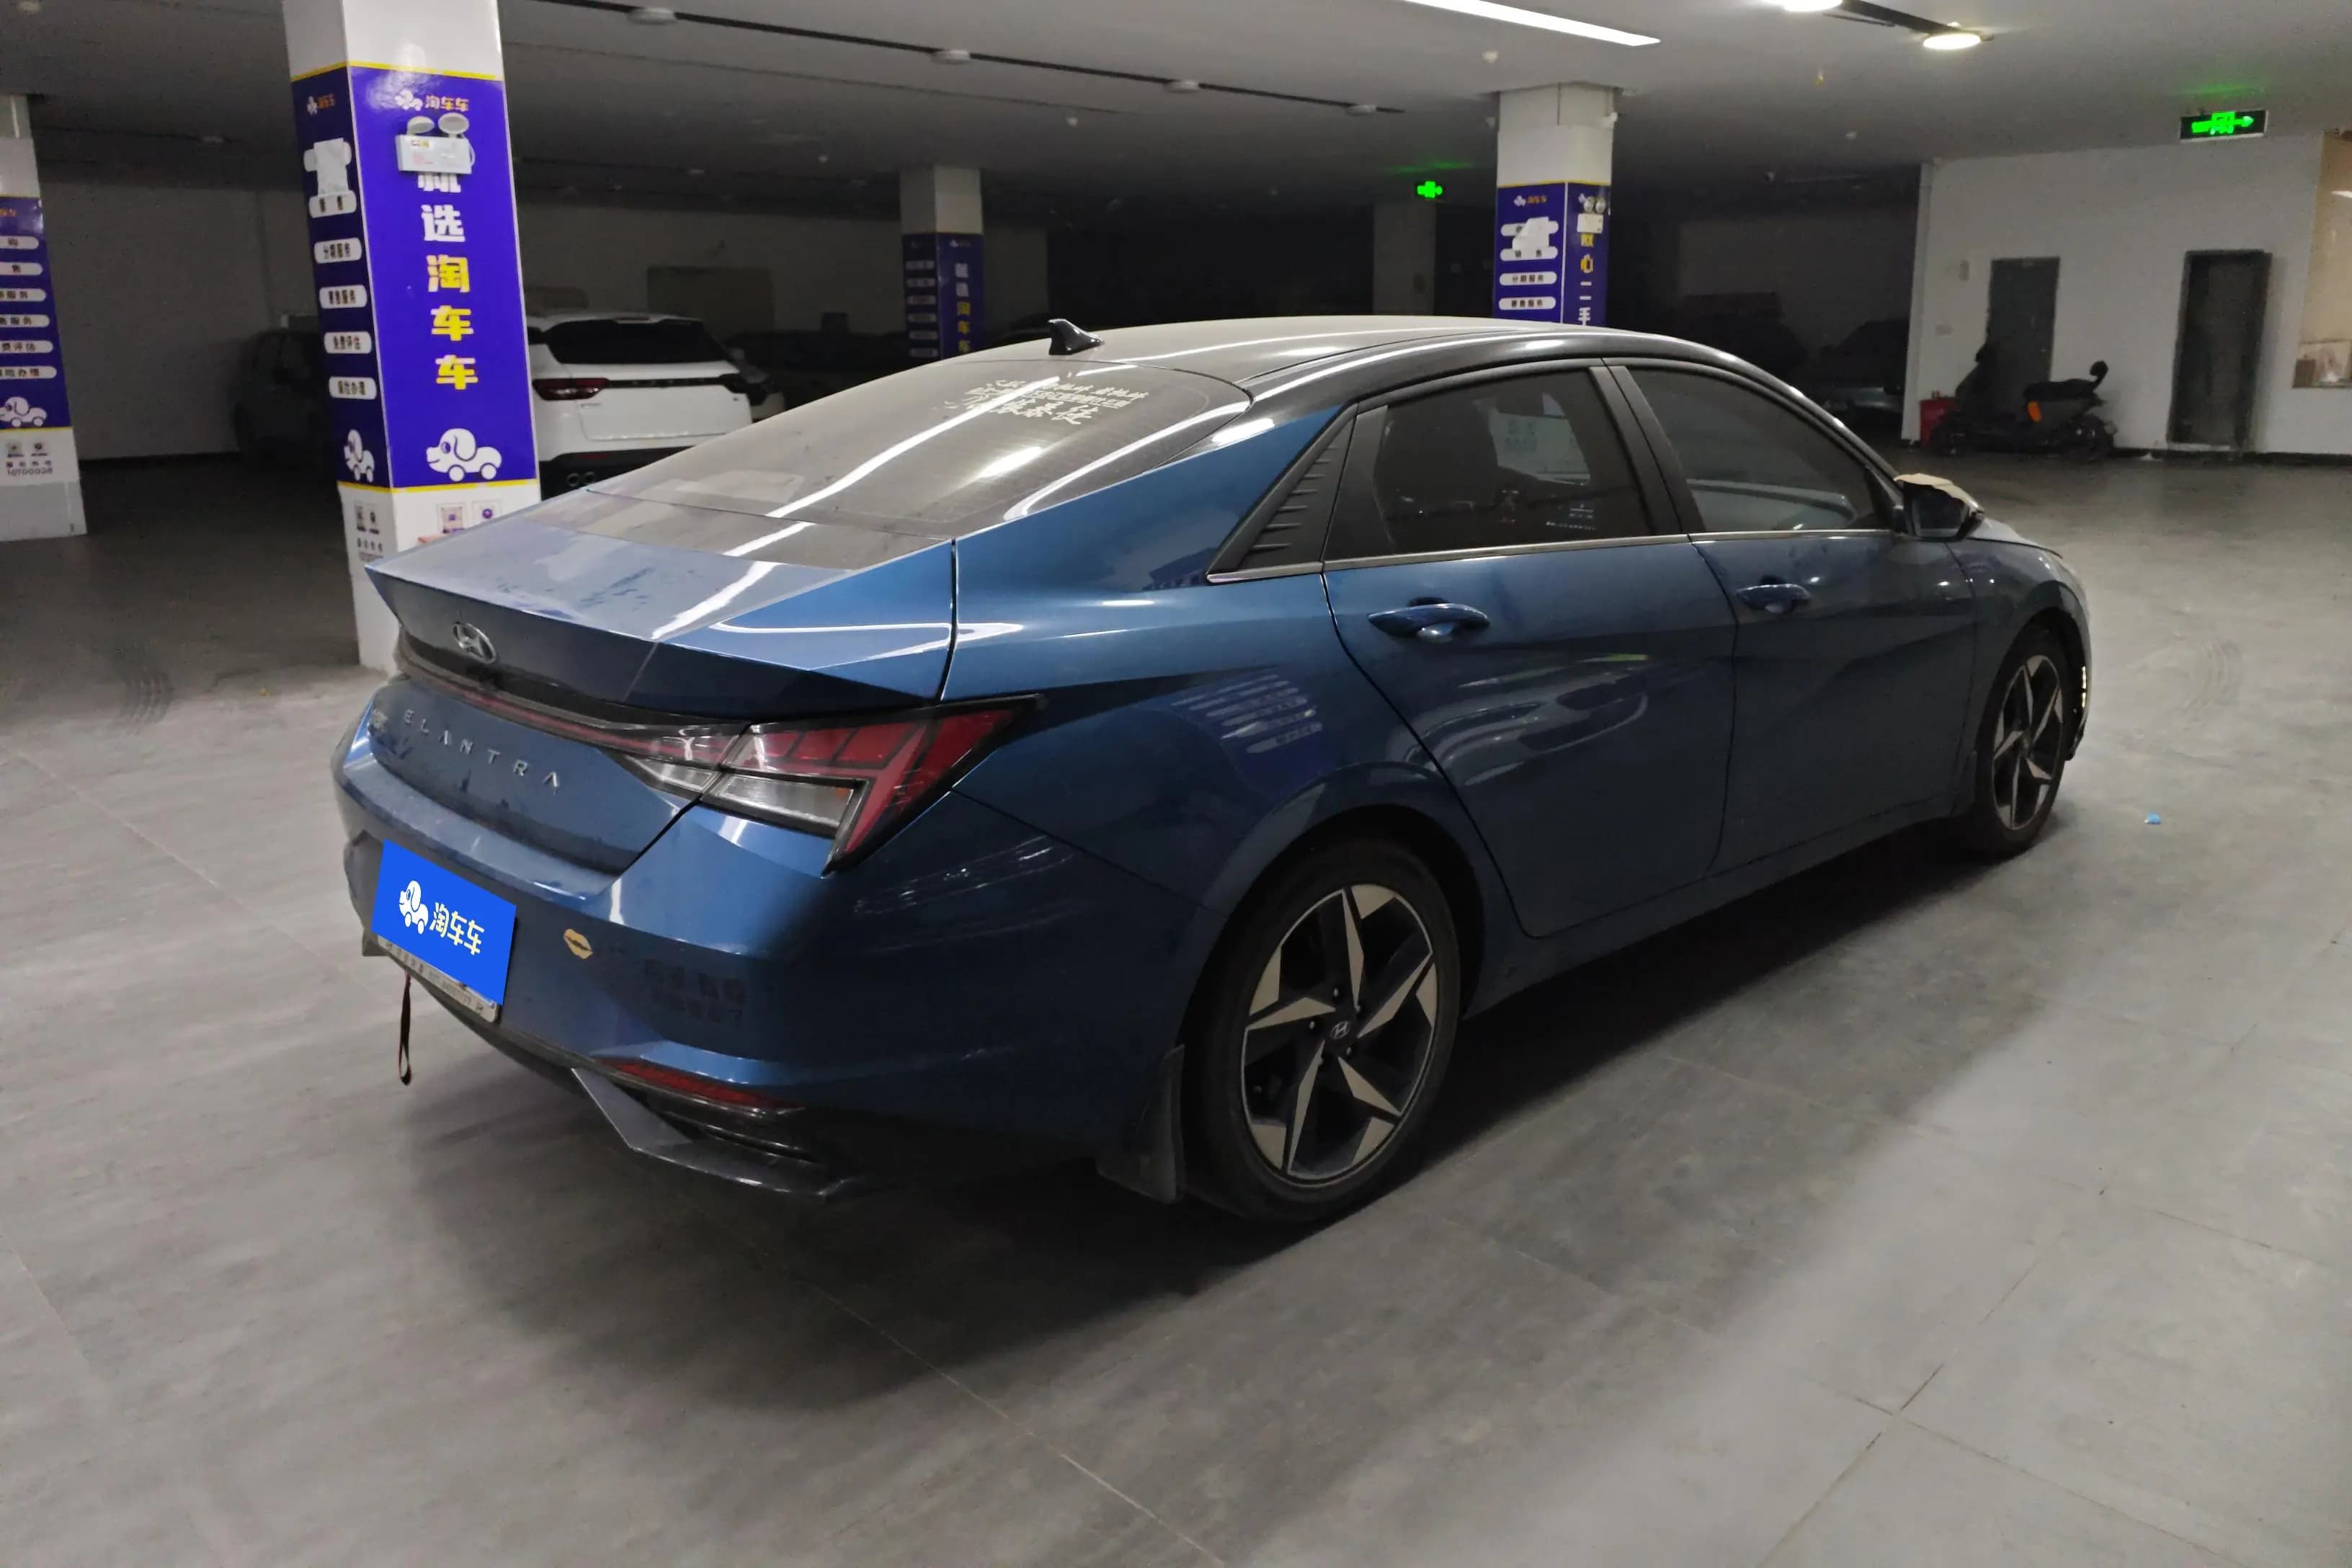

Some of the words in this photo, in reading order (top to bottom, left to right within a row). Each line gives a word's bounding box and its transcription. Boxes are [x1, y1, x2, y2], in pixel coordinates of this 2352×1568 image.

[425, 94, 468, 112] 淘车车
[404, 709, 561, 793] ELANTRA
